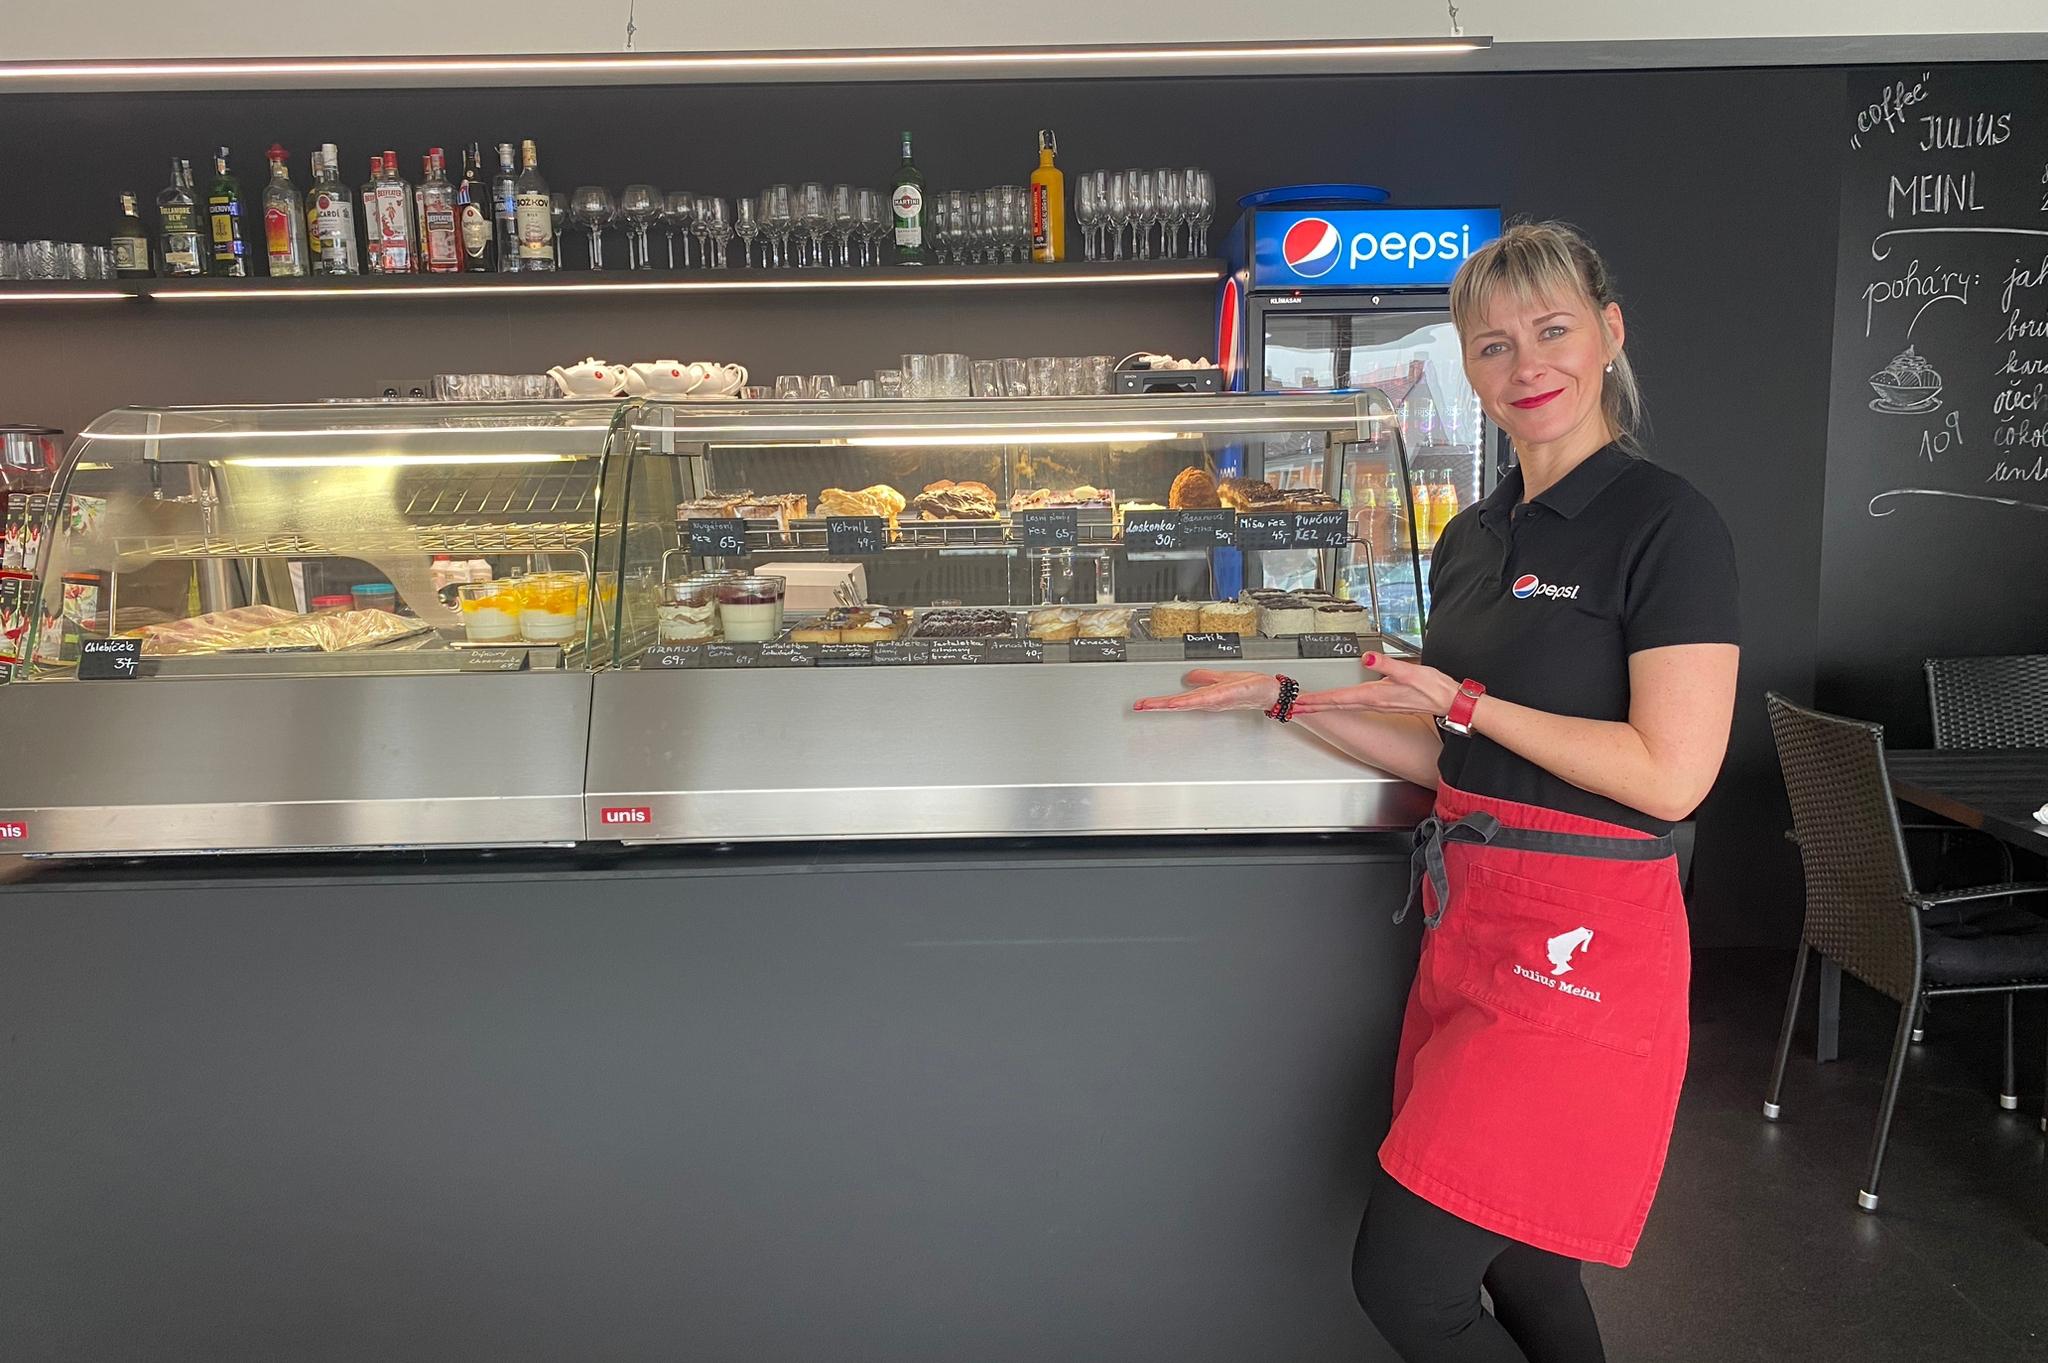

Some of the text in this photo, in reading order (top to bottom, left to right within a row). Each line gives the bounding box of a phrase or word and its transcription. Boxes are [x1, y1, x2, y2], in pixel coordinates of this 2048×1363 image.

[1920, 112, 2012, 151] JULIUS
[894, 198, 920, 207] MARTINI
[1888, 170, 1985, 220] MEINL
[1350, 223, 1470, 270] pepsi
[1861, 259, 1980, 338] poháry:
[1918, 411, 1963, 462] 109
[1533, 584, 1581, 601] pepsi
[84, 640, 135, 653] Chlebíček
[606, 809, 646, 822] unis
[1512, 964, 1601, 1003] Julius Meinl
